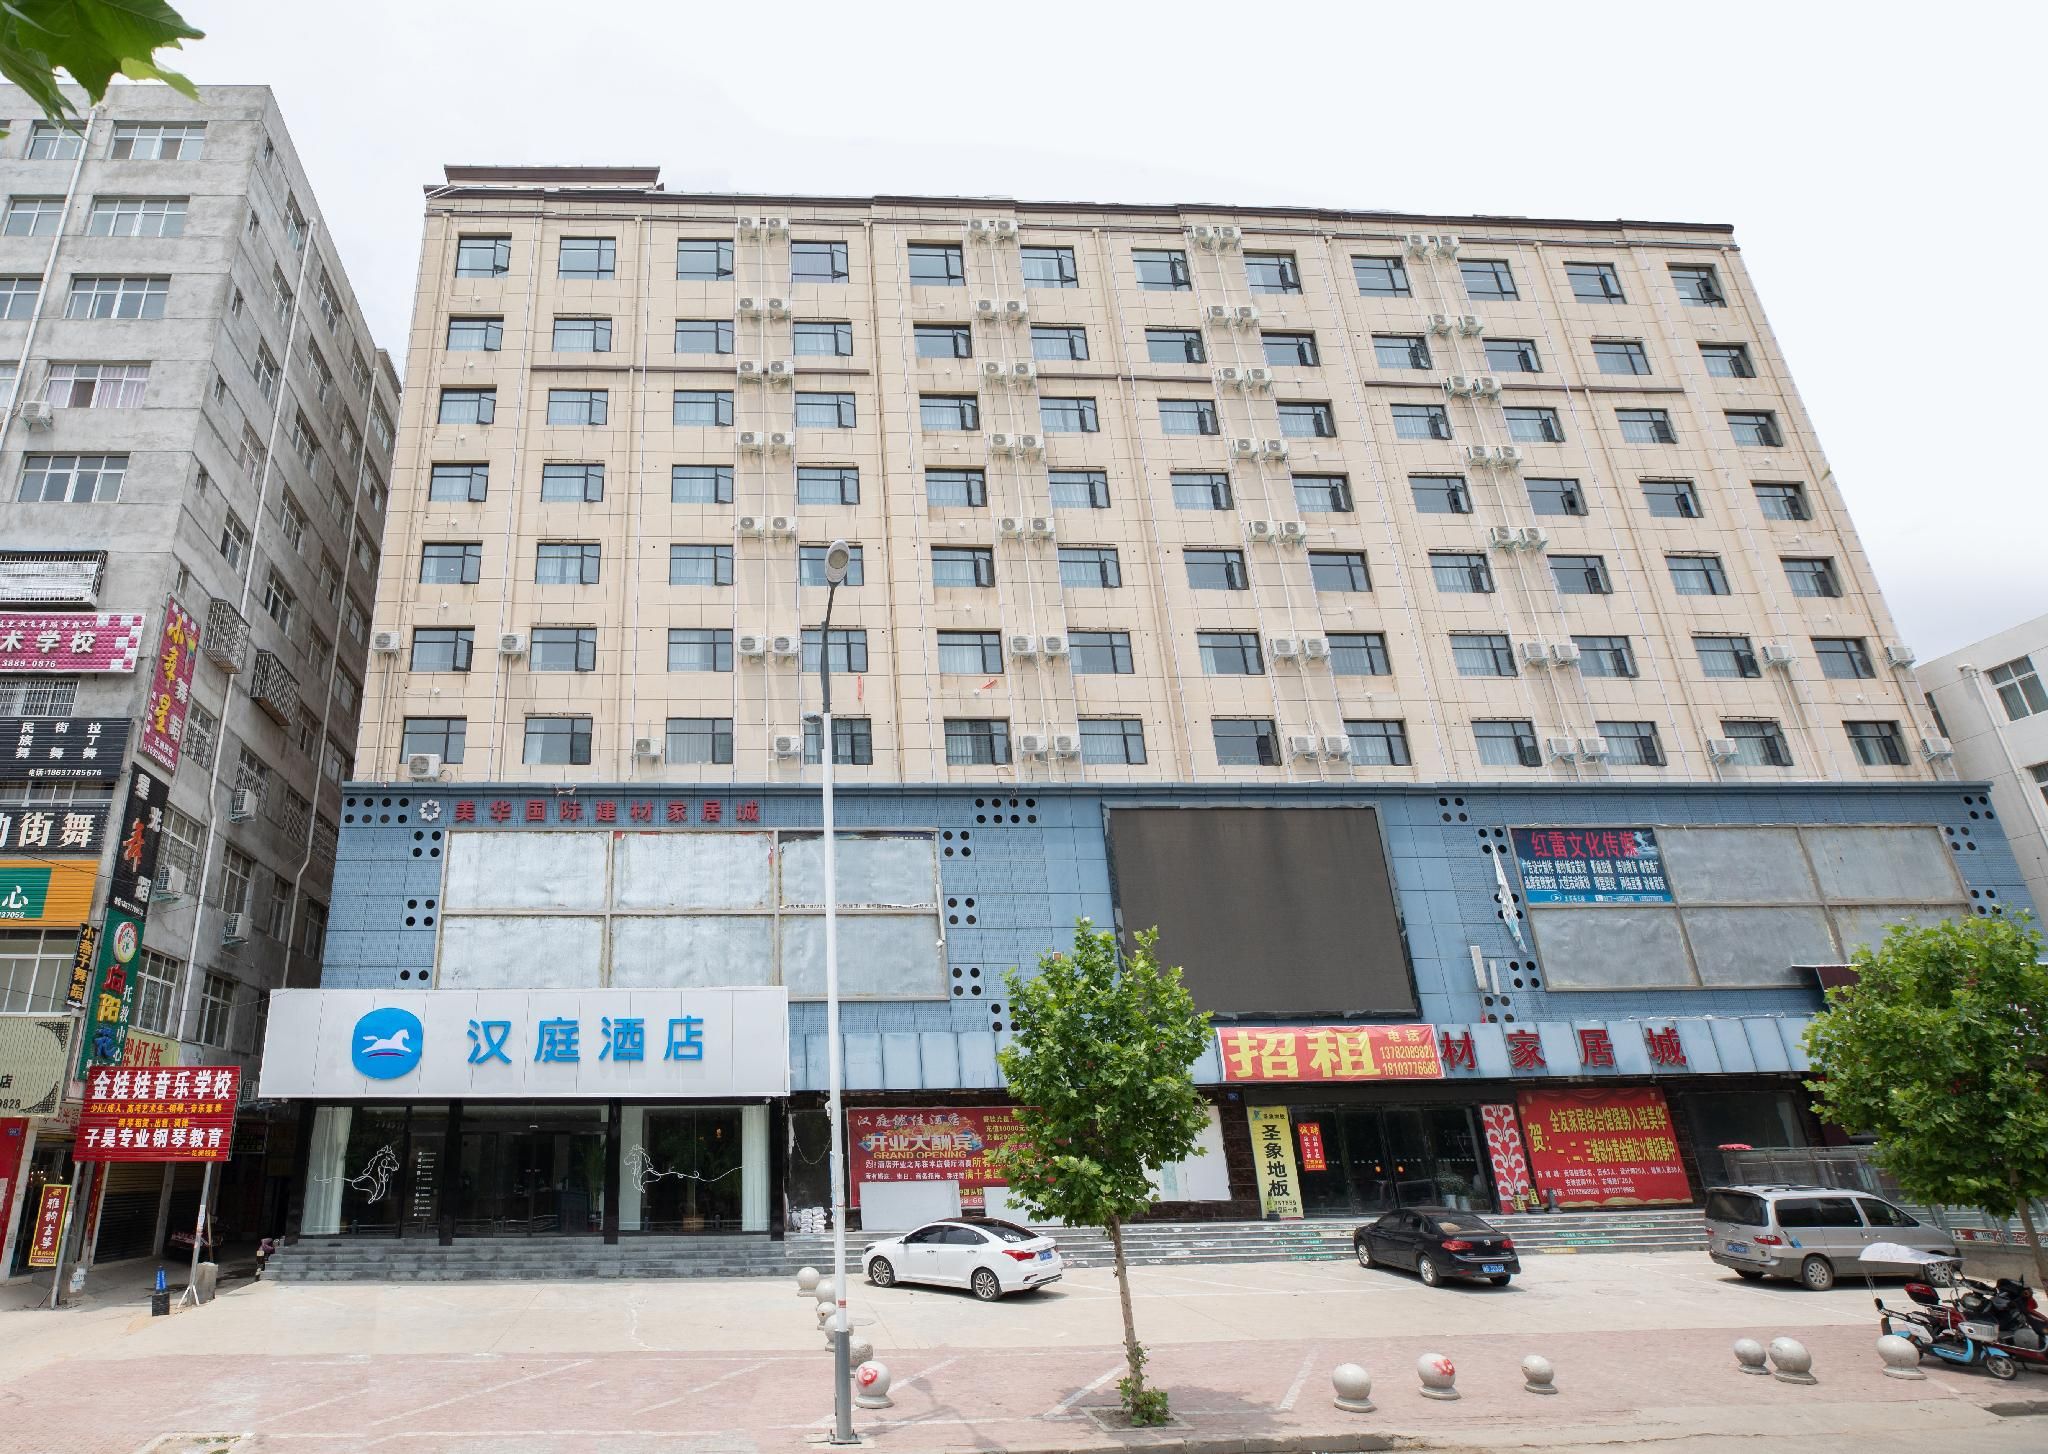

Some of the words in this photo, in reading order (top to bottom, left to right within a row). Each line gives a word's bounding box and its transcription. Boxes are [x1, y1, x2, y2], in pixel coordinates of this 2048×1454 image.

[0, 630, 98, 653] 术学校
[16, 722, 35, 759] 民族舞
[49, 722, 70, 759] 街舞
[82, 722, 102, 759] 拉丁舞
[454, 799, 762, 823] 美华国际建材家居城
[1531, 831, 1640, 858] 红雷文化传媒
[94, 963, 127, 1058] 向阳花
[466, 1015, 704, 1065] 汉庭酒店
[1388, 1029, 1419, 1042] 电话
[1440, 1027, 1687, 1070] 材家居城
[1227, 1030, 1381, 1078] 招租
[92, 1069, 232, 1100] 金娃娃音乐学校
[867, 1134, 973, 1151] 开业大酬宾
[873, 1151, 914, 1159] GRAND
[916, 1150, 967, 1159] OPENING
[1528, 1122, 1553, 1153] 贺:
[1262, 1124, 1290, 1197] 圣象地板
